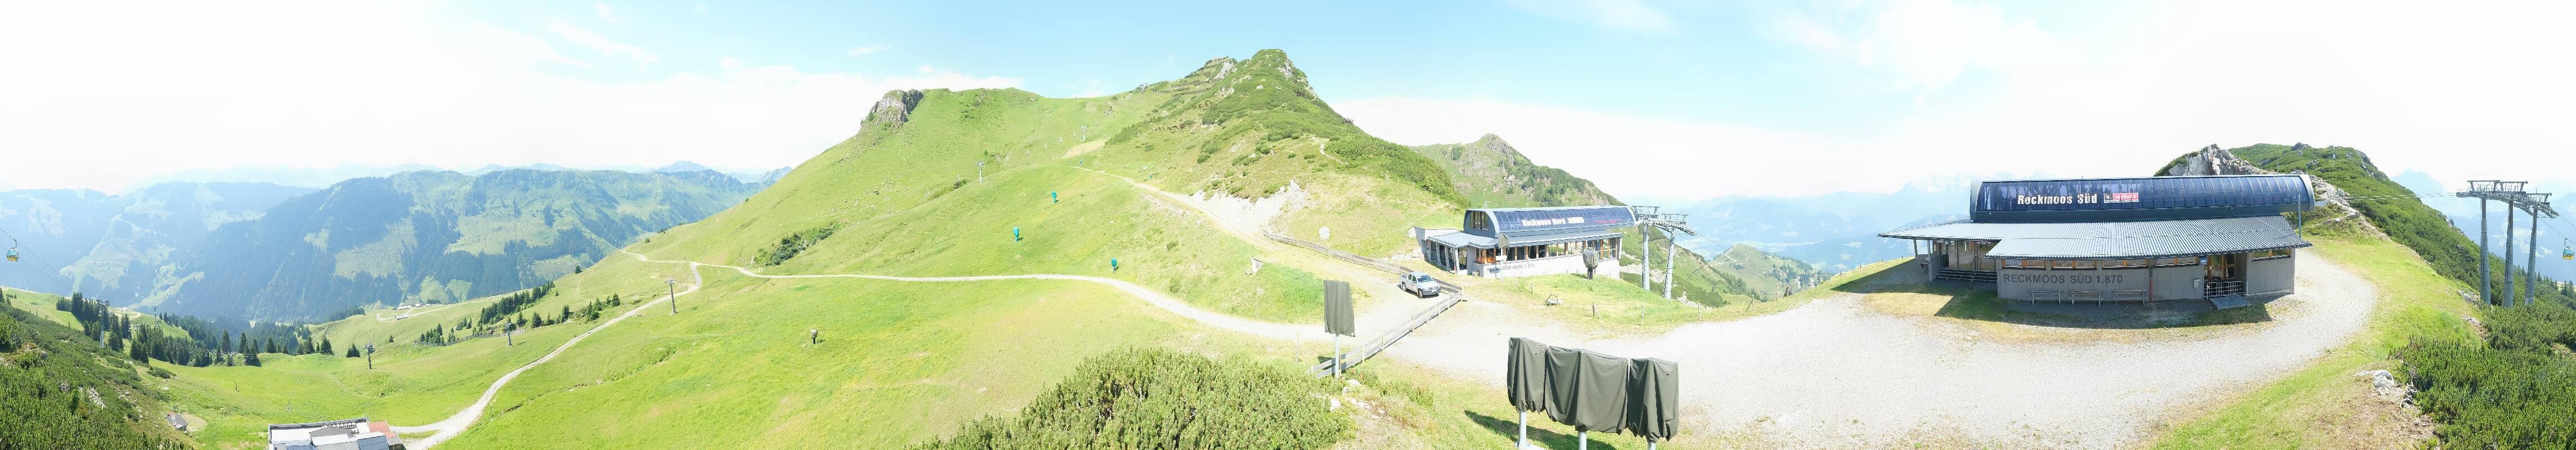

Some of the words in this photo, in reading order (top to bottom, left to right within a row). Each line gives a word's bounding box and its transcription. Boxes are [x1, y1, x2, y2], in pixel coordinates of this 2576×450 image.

[2017, 195, 2073, 205] Reckmoos
[2077, 193, 2097, 204] Süd
[2003, 274, 2065, 284] RECKMOOS
[2070, 274, 2092, 284] SÜD
[2096, 274, 2123, 284] 1.870
